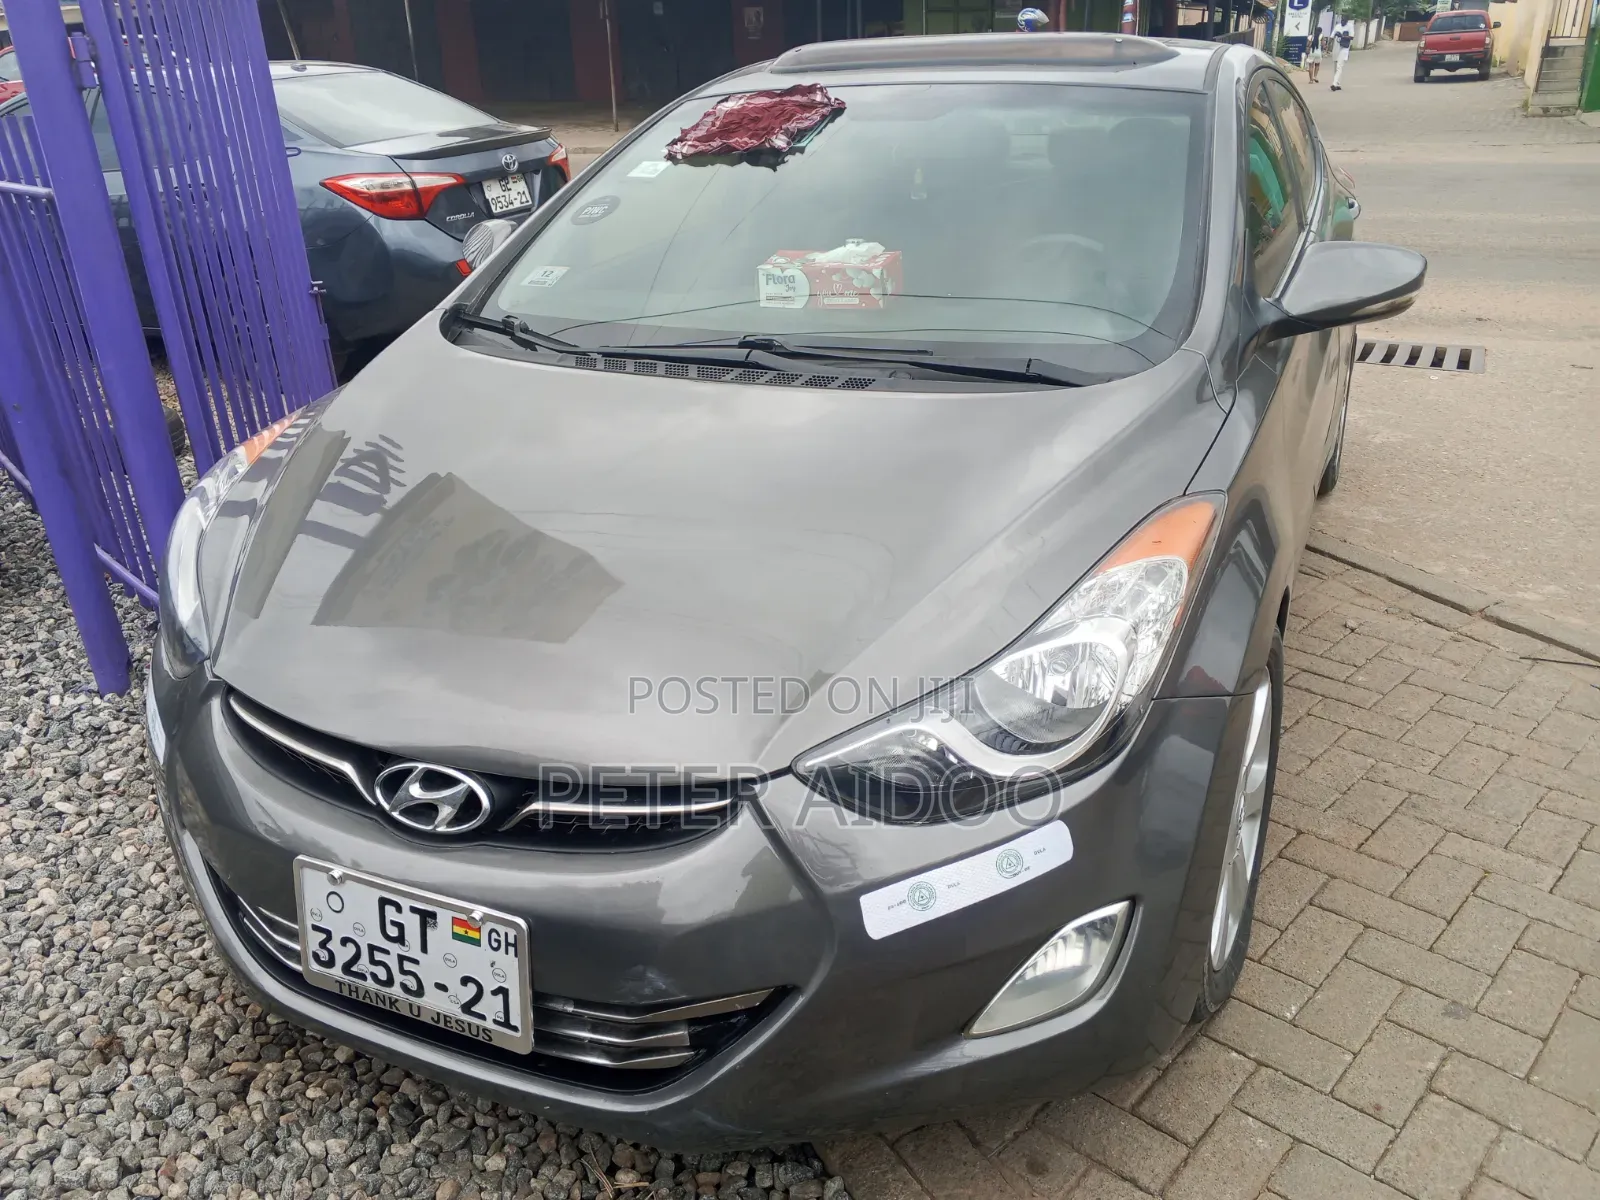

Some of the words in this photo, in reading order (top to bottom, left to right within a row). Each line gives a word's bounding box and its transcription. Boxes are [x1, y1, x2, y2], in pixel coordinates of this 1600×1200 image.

[491, 190, 530, 211] 9534-21
[446, 212, 475, 222] COROLLA
[541, 270, 554, 278] 12
[765, 273, 796, 285] Flora
[378, 895, 438, 954] GT
[487, 927, 519, 958] GH
[311, 924, 519, 1033] 3255-21
[335, 980, 401, 1012] THANK
[408, 1005, 421, 1018] U
[431, 1011, 493, 1043] JESUS
